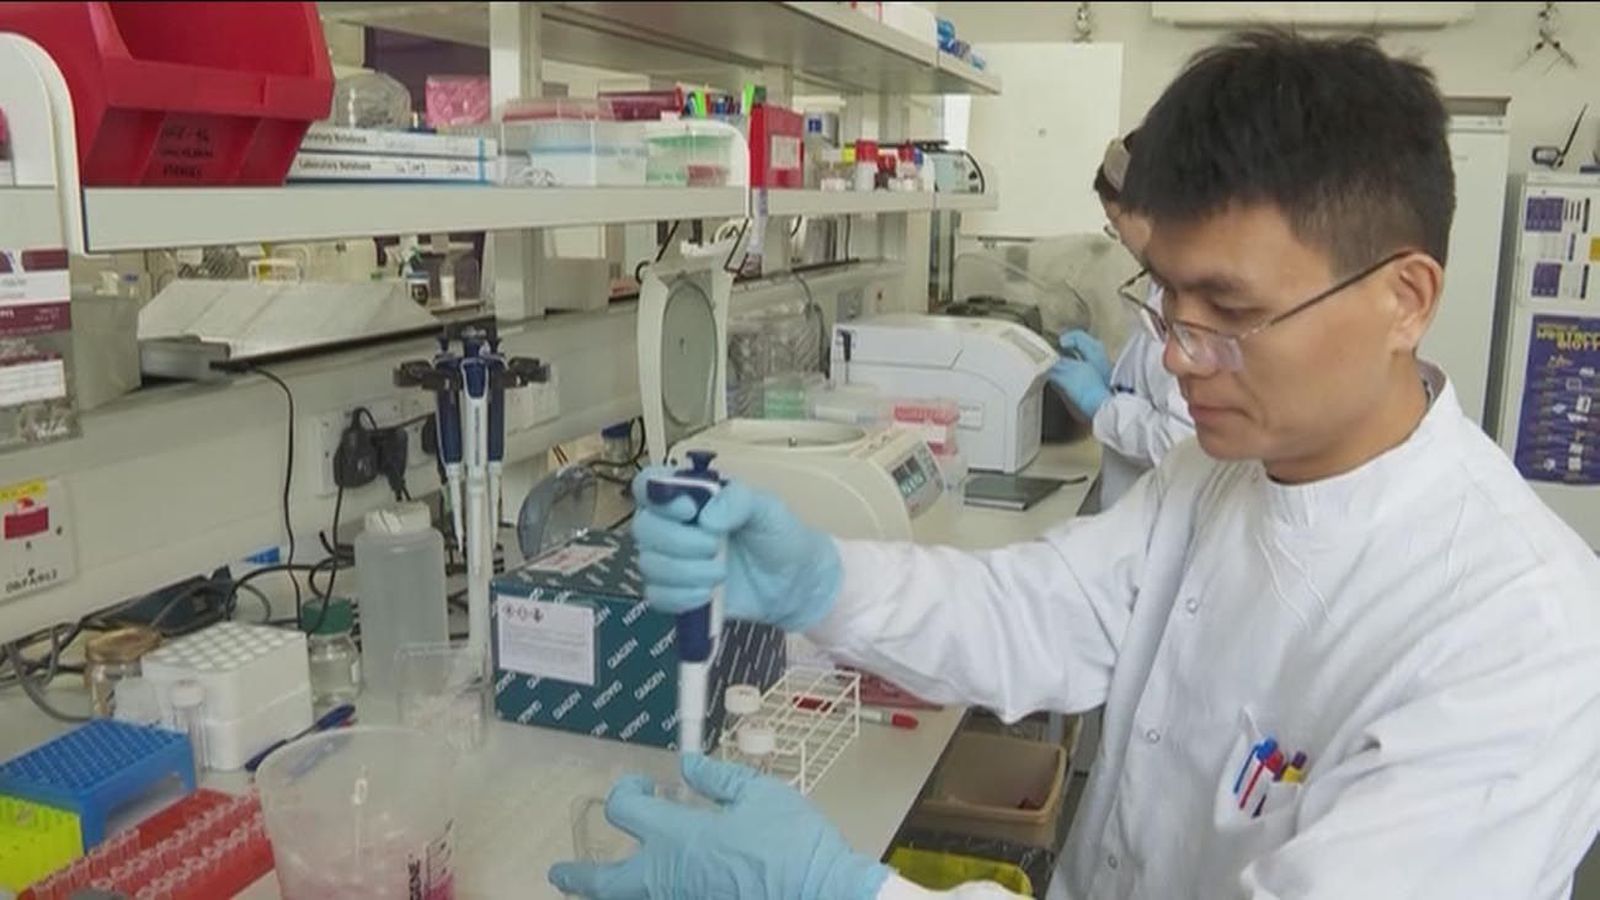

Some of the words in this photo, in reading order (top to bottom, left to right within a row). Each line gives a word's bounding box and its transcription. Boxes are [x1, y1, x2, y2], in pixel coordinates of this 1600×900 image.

[606, 637, 638, 669] QIAGEN
[592, 679, 623, 710] QIAGEN
[634, 669, 667, 701] QIAGEN
[551, 689, 582, 721] QIAGEN
[618, 710, 650, 741] QIAGEN
